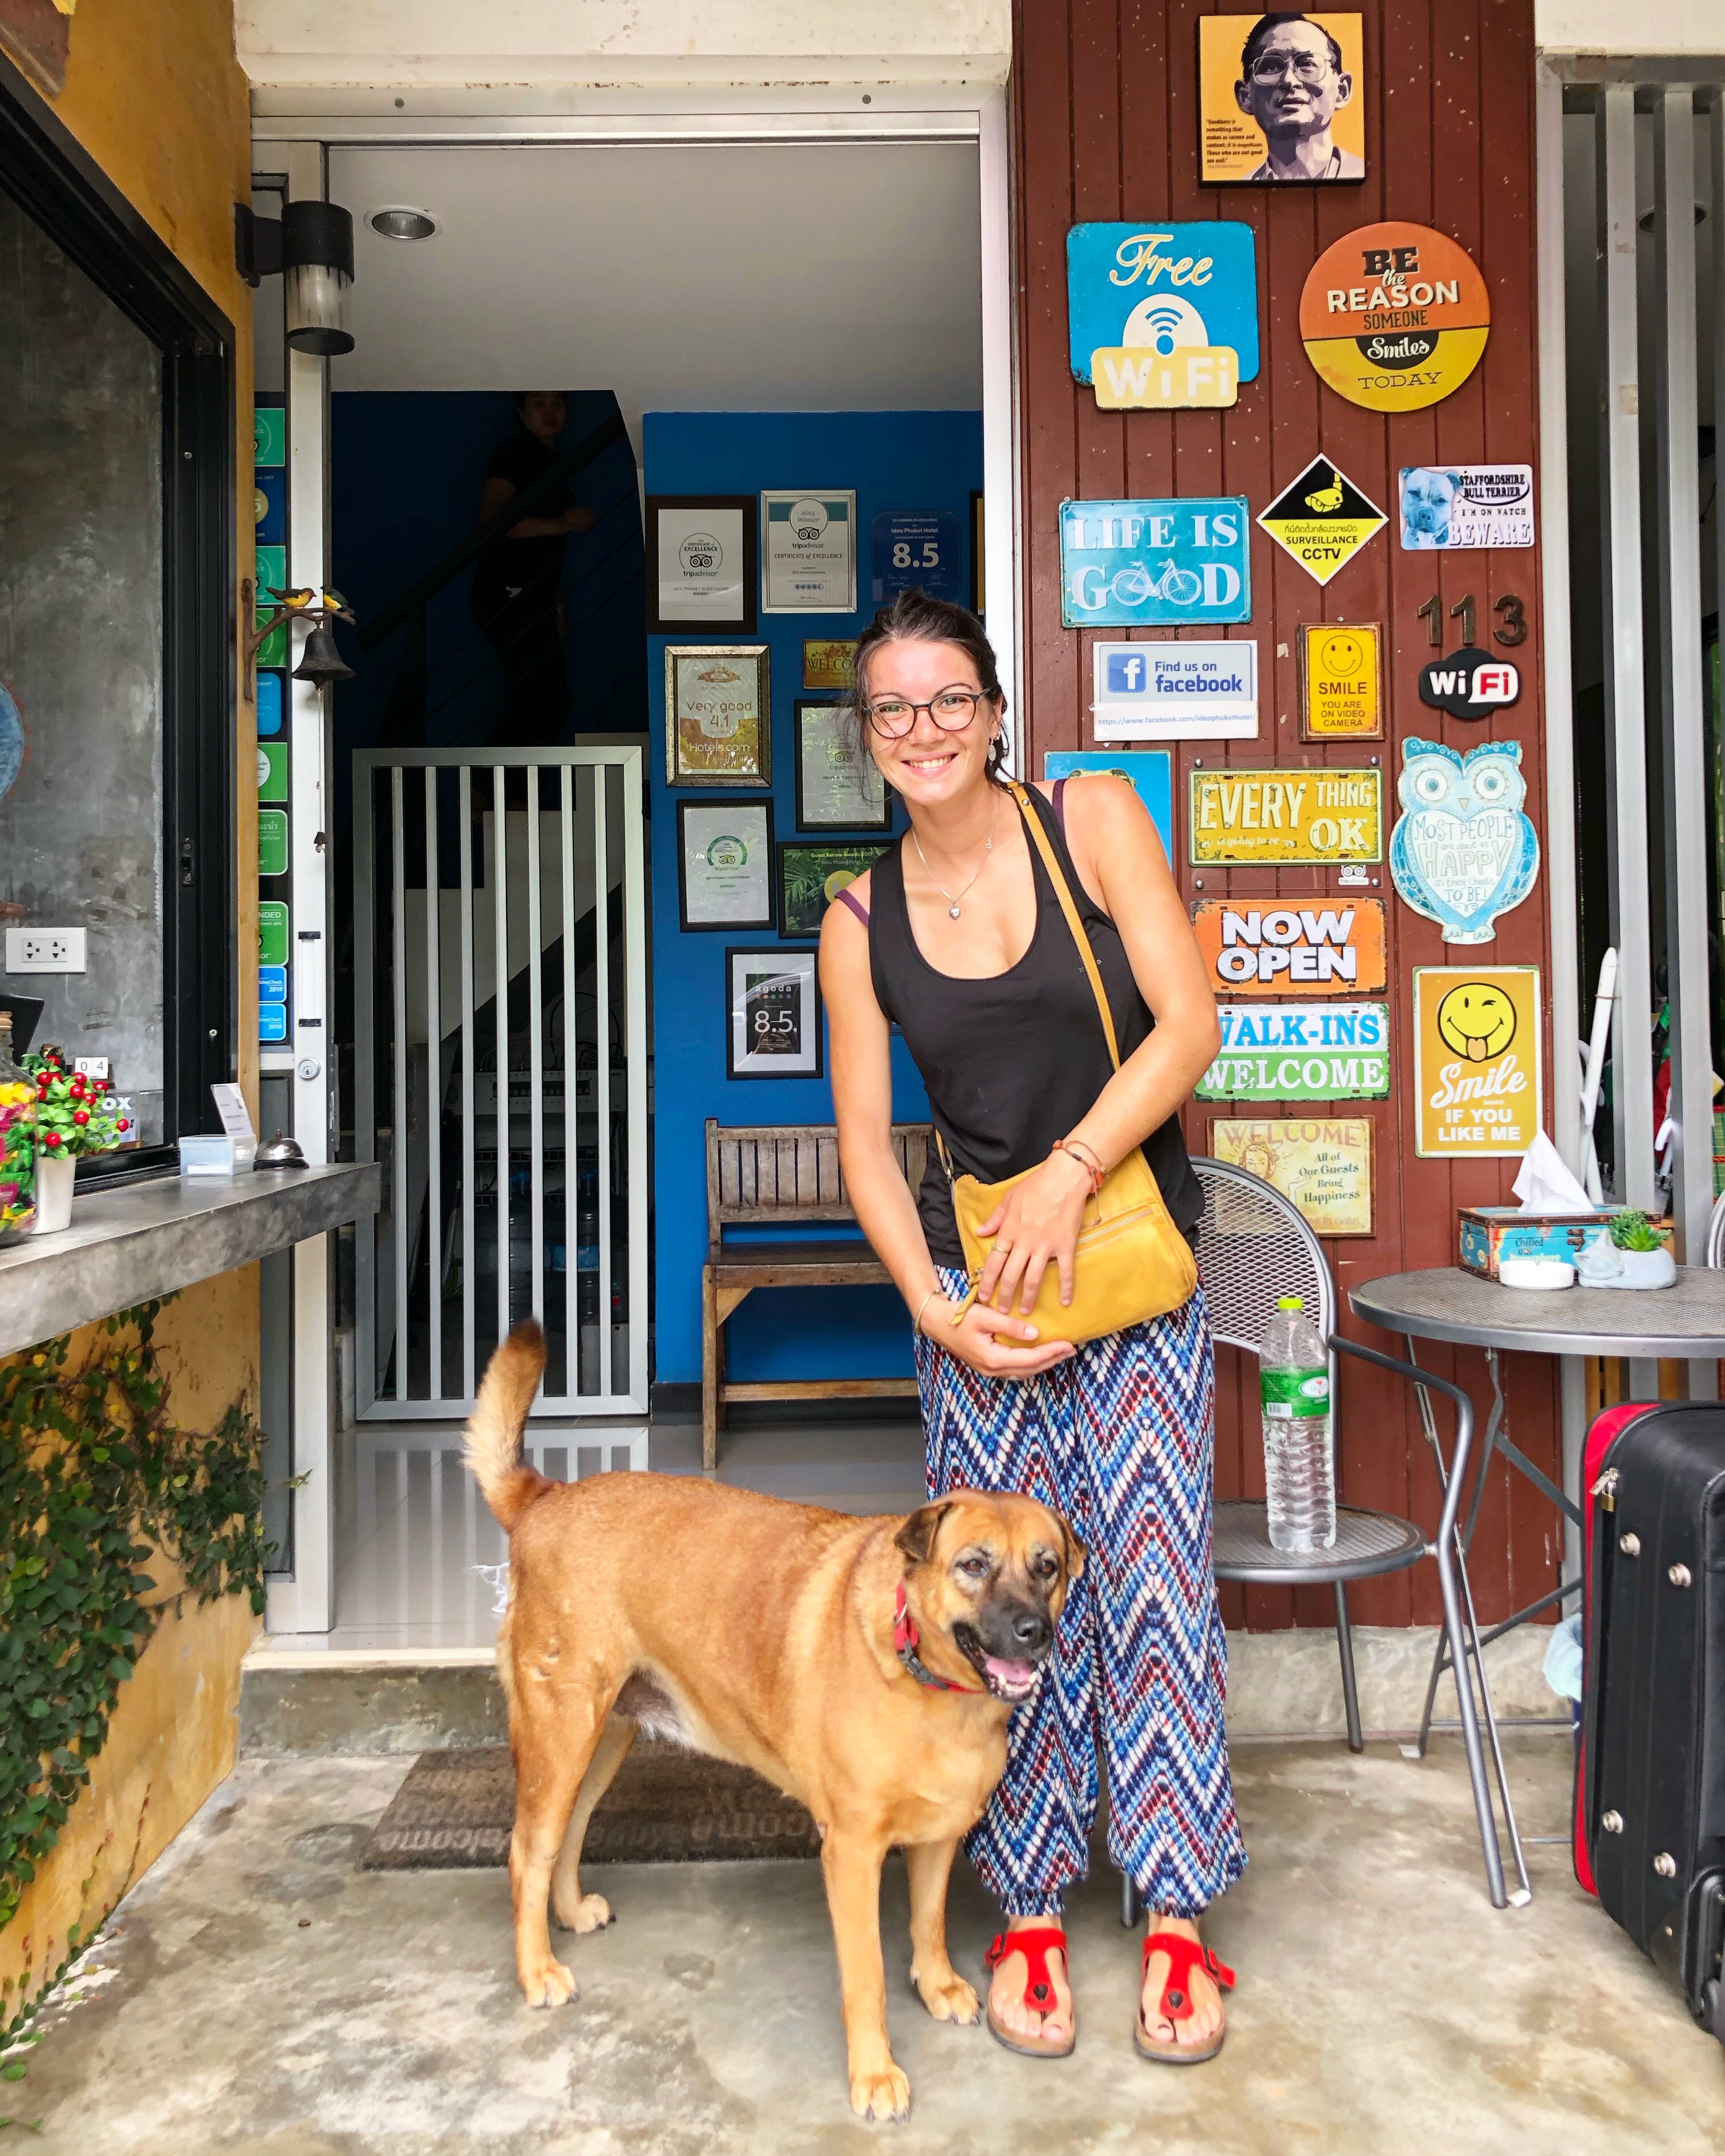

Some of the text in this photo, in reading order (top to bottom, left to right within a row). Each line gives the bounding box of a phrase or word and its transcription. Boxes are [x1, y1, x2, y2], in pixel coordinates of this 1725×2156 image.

[1109, 233, 1213, 286] Free
[1362, 246, 1420, 278] BE
[1379, 269, 1406, 286] the
[1327, 279, 1460, 314] REASON
[1363, 310, 1428, 330] SOMEONE
[1367, 337, 1430, 359] Smiles
[1358, 371, 1443, 390] TODAY
[1460, 474, 1525, 485] STAFFORDSHIRE
[1464, 487, 1521, 498] BULL TERRIER
[1070, 514, 1238, 550] LIFE IS
[1286, 536, 1358, 544] SURVEILLANCE
[1448, 520, 1531, 546] BEWARE
[893, 542, 939, 568] 8.5
[1302, 548, 1341, 560] CCTV
[1418, 593, 1527, 645] 113
[808, 658, 852, 670] WELCO
[1155, 661, 1217, 672] Find us on
[1155, 674, 1242, 692] facebook
[1318, 682, 1367, 694] SMILE
[686, 701, 752, 713] Very good
[710, 715, 729, 727] 4.1
[689, 741, 750, 752] Hotels.com
[1200, 782, 1372, 829] EVERY THING
[1217, 836, 1225, 845] is
[1227, 837, 1254, 848] going
[1309, 818, 1370, 851] OK
[1414, 815, 1513, 841] MOST PEOPLE
[1418, 840, 1511, 878] HAPPY
[1446, 878, 1465, 889] they
[1444, 889, 1463, 902] TO
[1222, 910, 1355, 947] NOW
[1216, 946, 1356, 983] OPEN
[756, 984, 792, 994] agoda
[1202, 1058, 1384, 1089] WELCOME
[1430, 1055, 1528, 1109] Smile
[102, 1097, 132, 1111] OX
[1445, 1109, 1512, 1123] IF YOU
[1223, 1122, 1361, 1148] WELCOME
[1438, 1126, 1521, 1141] LIKE ME
[1314, 1152, 1341, 1162] All of
[1299, 1164, 1358, 1176] Our Guests
[1318, 1178, 1343, 1188] Bring
[1304, 1192, 1360, 1205] Happiness
[1516, 1237, 1544, 1247] Chilled
